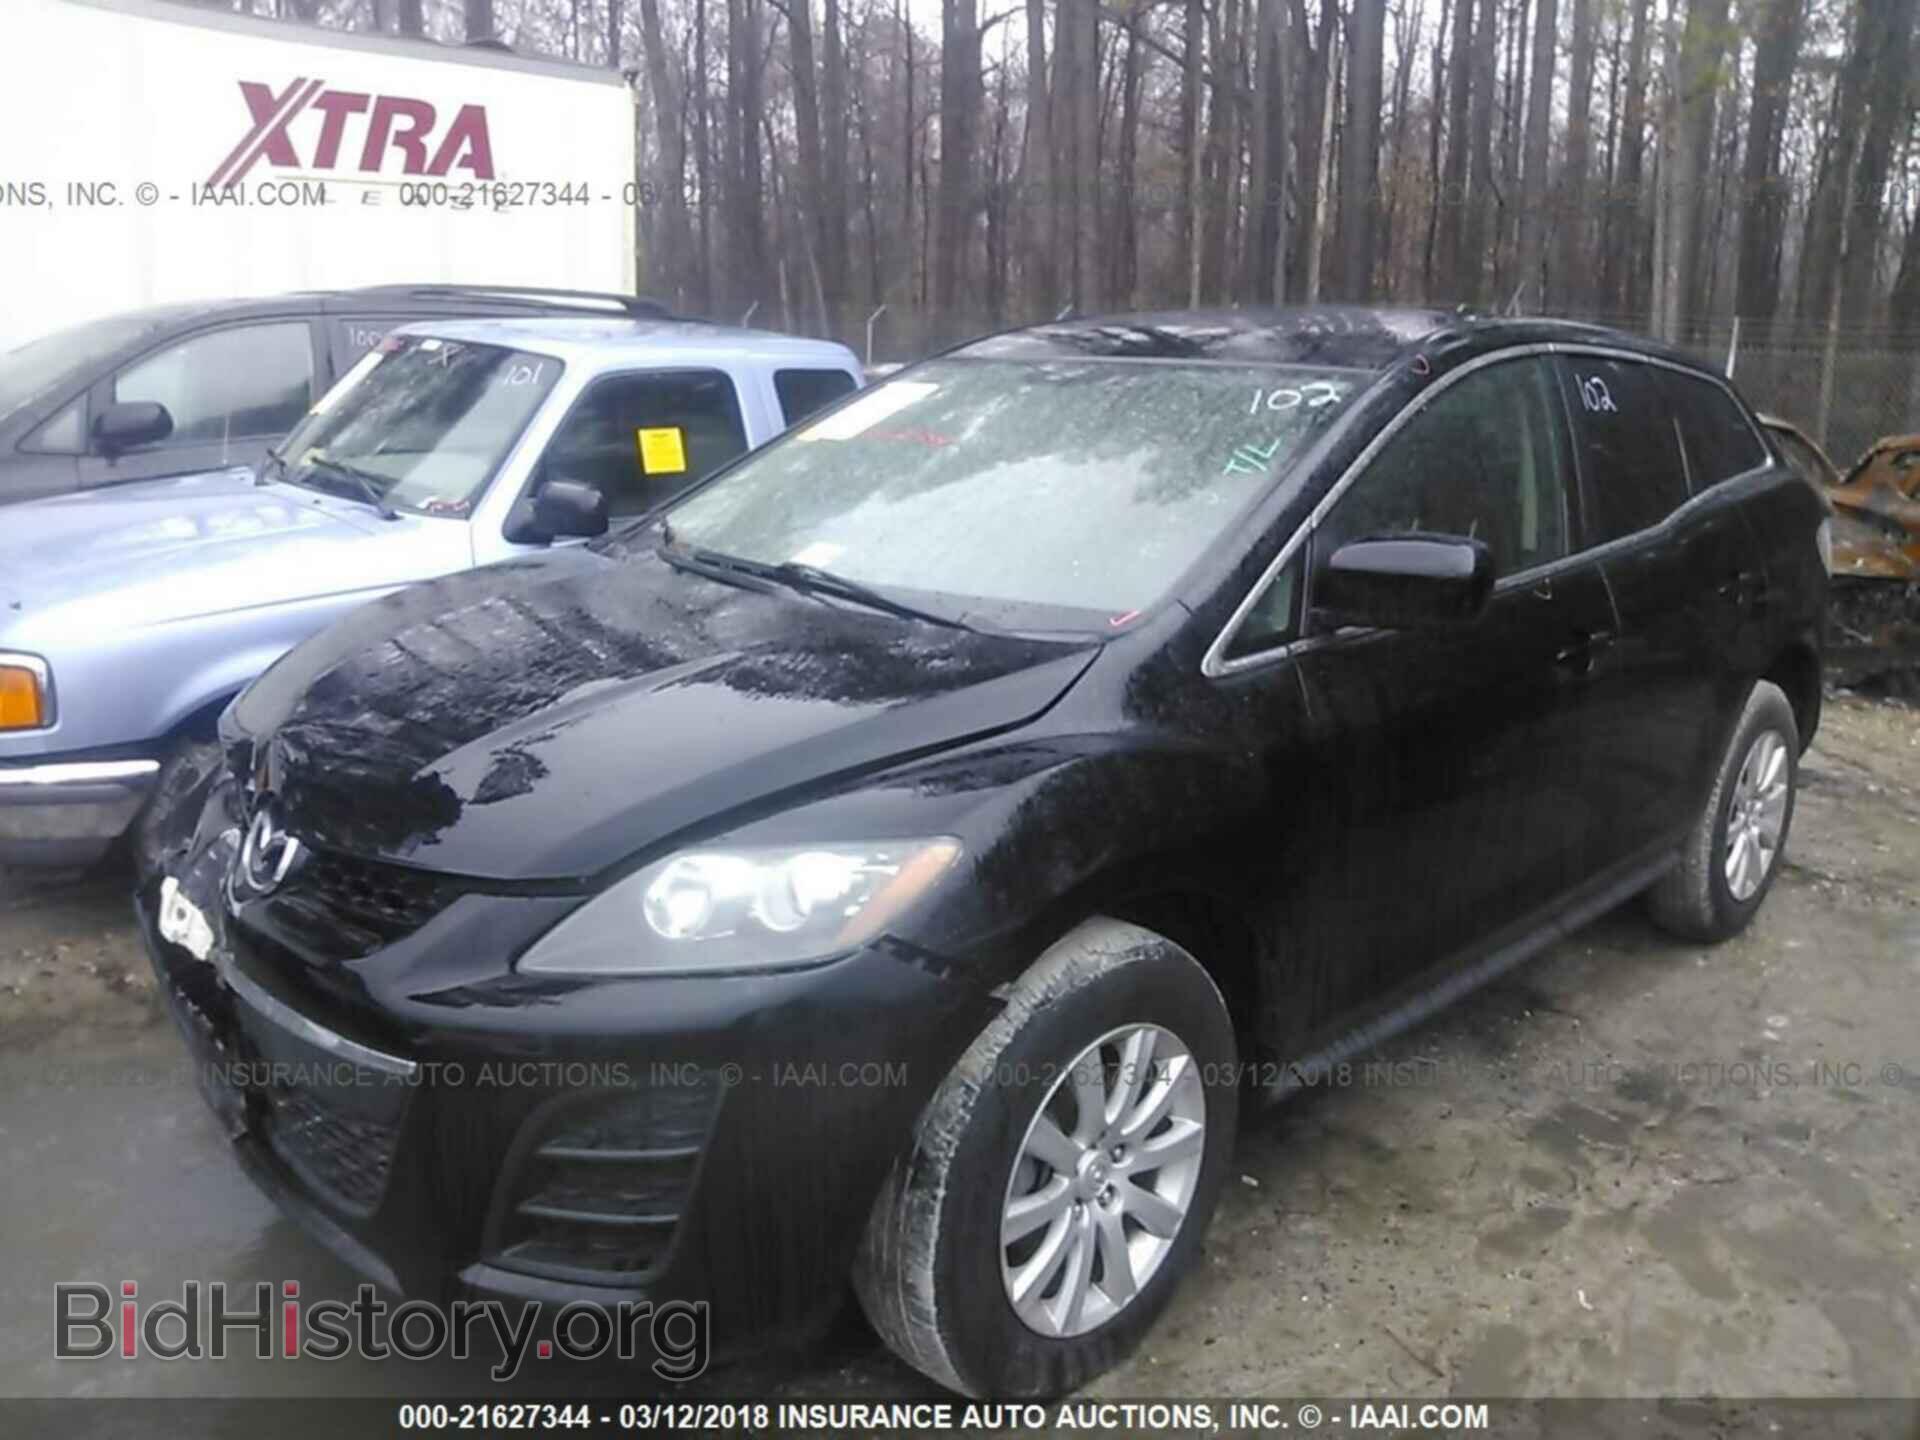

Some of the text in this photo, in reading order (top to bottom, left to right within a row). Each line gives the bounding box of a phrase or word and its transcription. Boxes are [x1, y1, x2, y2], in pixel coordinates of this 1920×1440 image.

[205, 77, 495, 188] XTRA
[504, 362, 543, 385] 101
[1250, 382, 1342, 414] 102
[1574, 373, 1618, 412] 102
[1223, 438, 1281, 475] T/L
